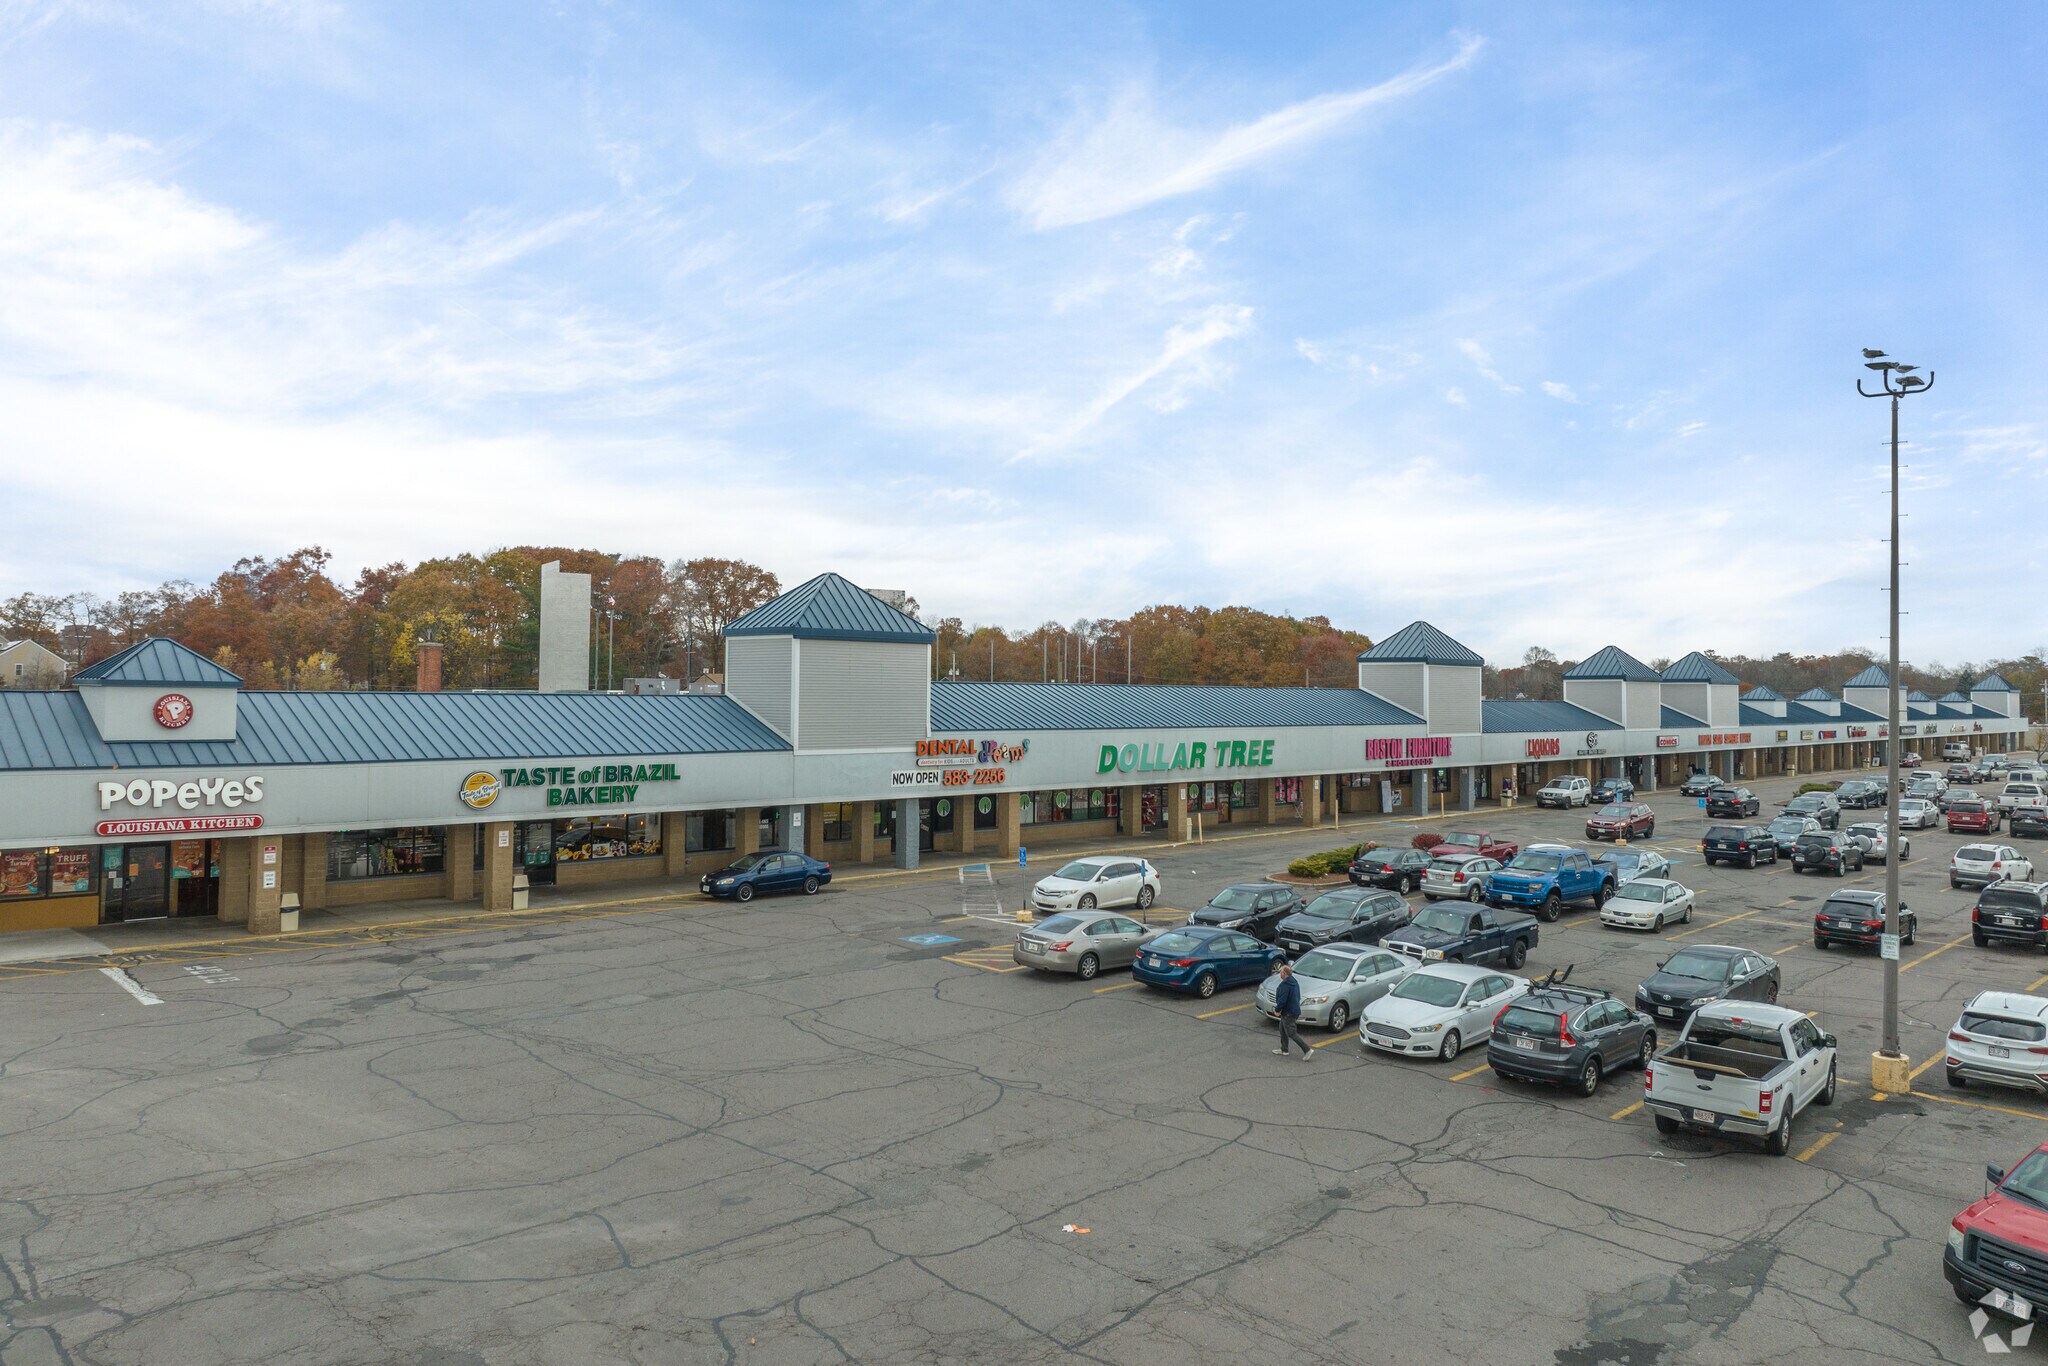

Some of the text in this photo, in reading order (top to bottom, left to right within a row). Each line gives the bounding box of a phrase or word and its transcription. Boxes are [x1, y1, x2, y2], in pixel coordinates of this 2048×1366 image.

[158, 696, 191, 710] LOUISIANA
[159, 715, 190, 728] KITCHEN
[916, 739, 977, 757] DENTAL
[1096, 740, 1275, 774] DOLLAR TREE
[1366, 736, 1452, 760] BOSTON FURNITURE
[1525, 737, 1560, 760] LIQUORS
[501, 763, 681, 787] TASTE of BRAZIL
[892, 768, 1006, 786] NOW OPEN 583-2256
[547, 785, 639, 807] BAKERY
[106, 817, 255, 834] LOUISIANA KITCHEN
[57, 854, 88, 862] TRUFF
